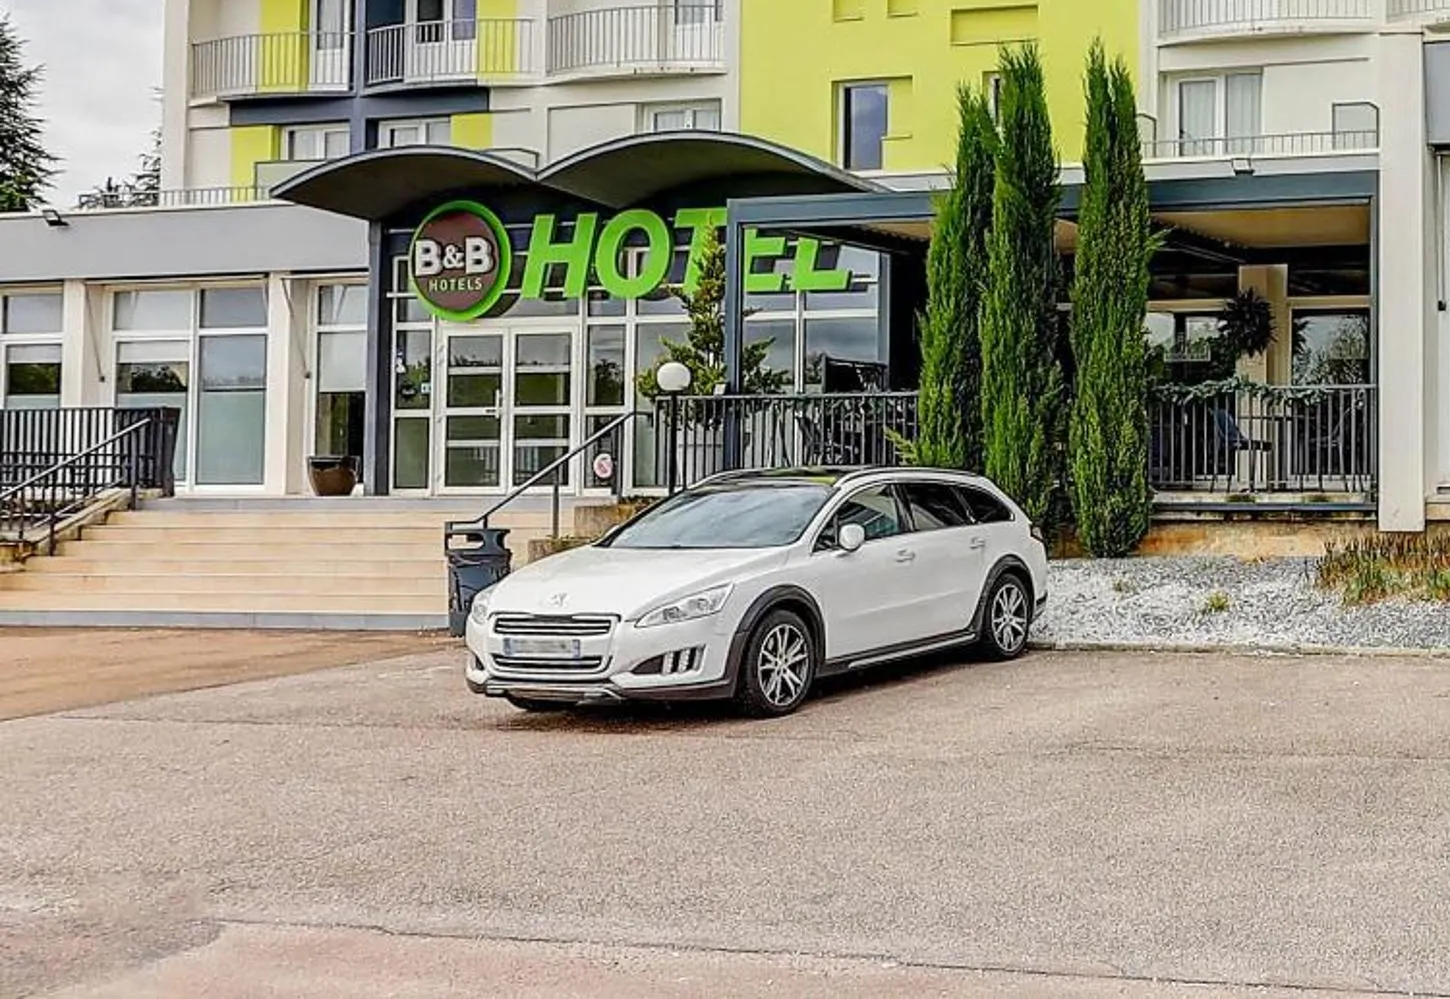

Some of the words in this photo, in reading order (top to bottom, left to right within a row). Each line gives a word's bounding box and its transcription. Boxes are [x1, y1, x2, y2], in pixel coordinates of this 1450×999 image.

[415, 236, 494, 276] B&B
[521, 206, 852, 299] HOTEL
[428, 278, 483, 292] HOTELS
